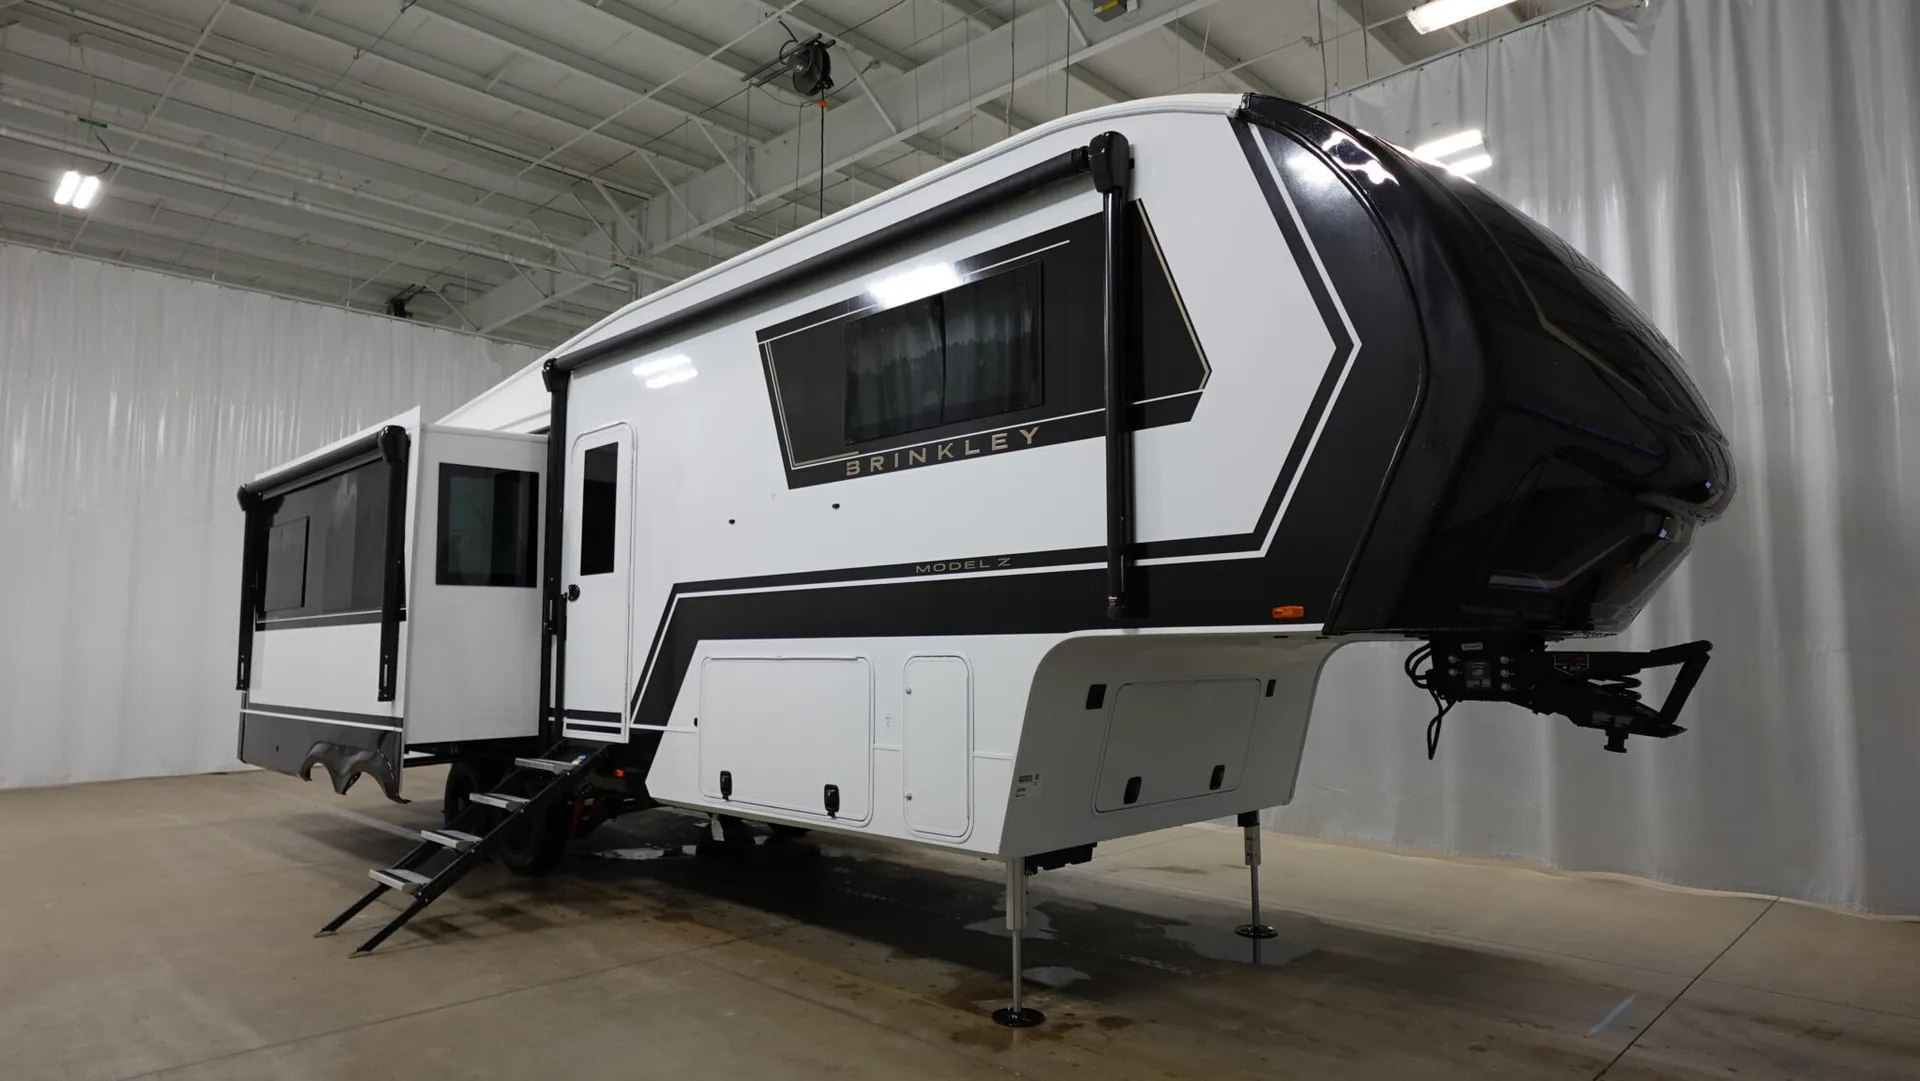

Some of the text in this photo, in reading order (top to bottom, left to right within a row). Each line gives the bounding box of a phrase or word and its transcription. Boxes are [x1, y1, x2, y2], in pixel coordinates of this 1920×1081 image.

[846, 427, 1040, 476] BRINKLEY
[915, 557, 1011, 574] MODEL Z
